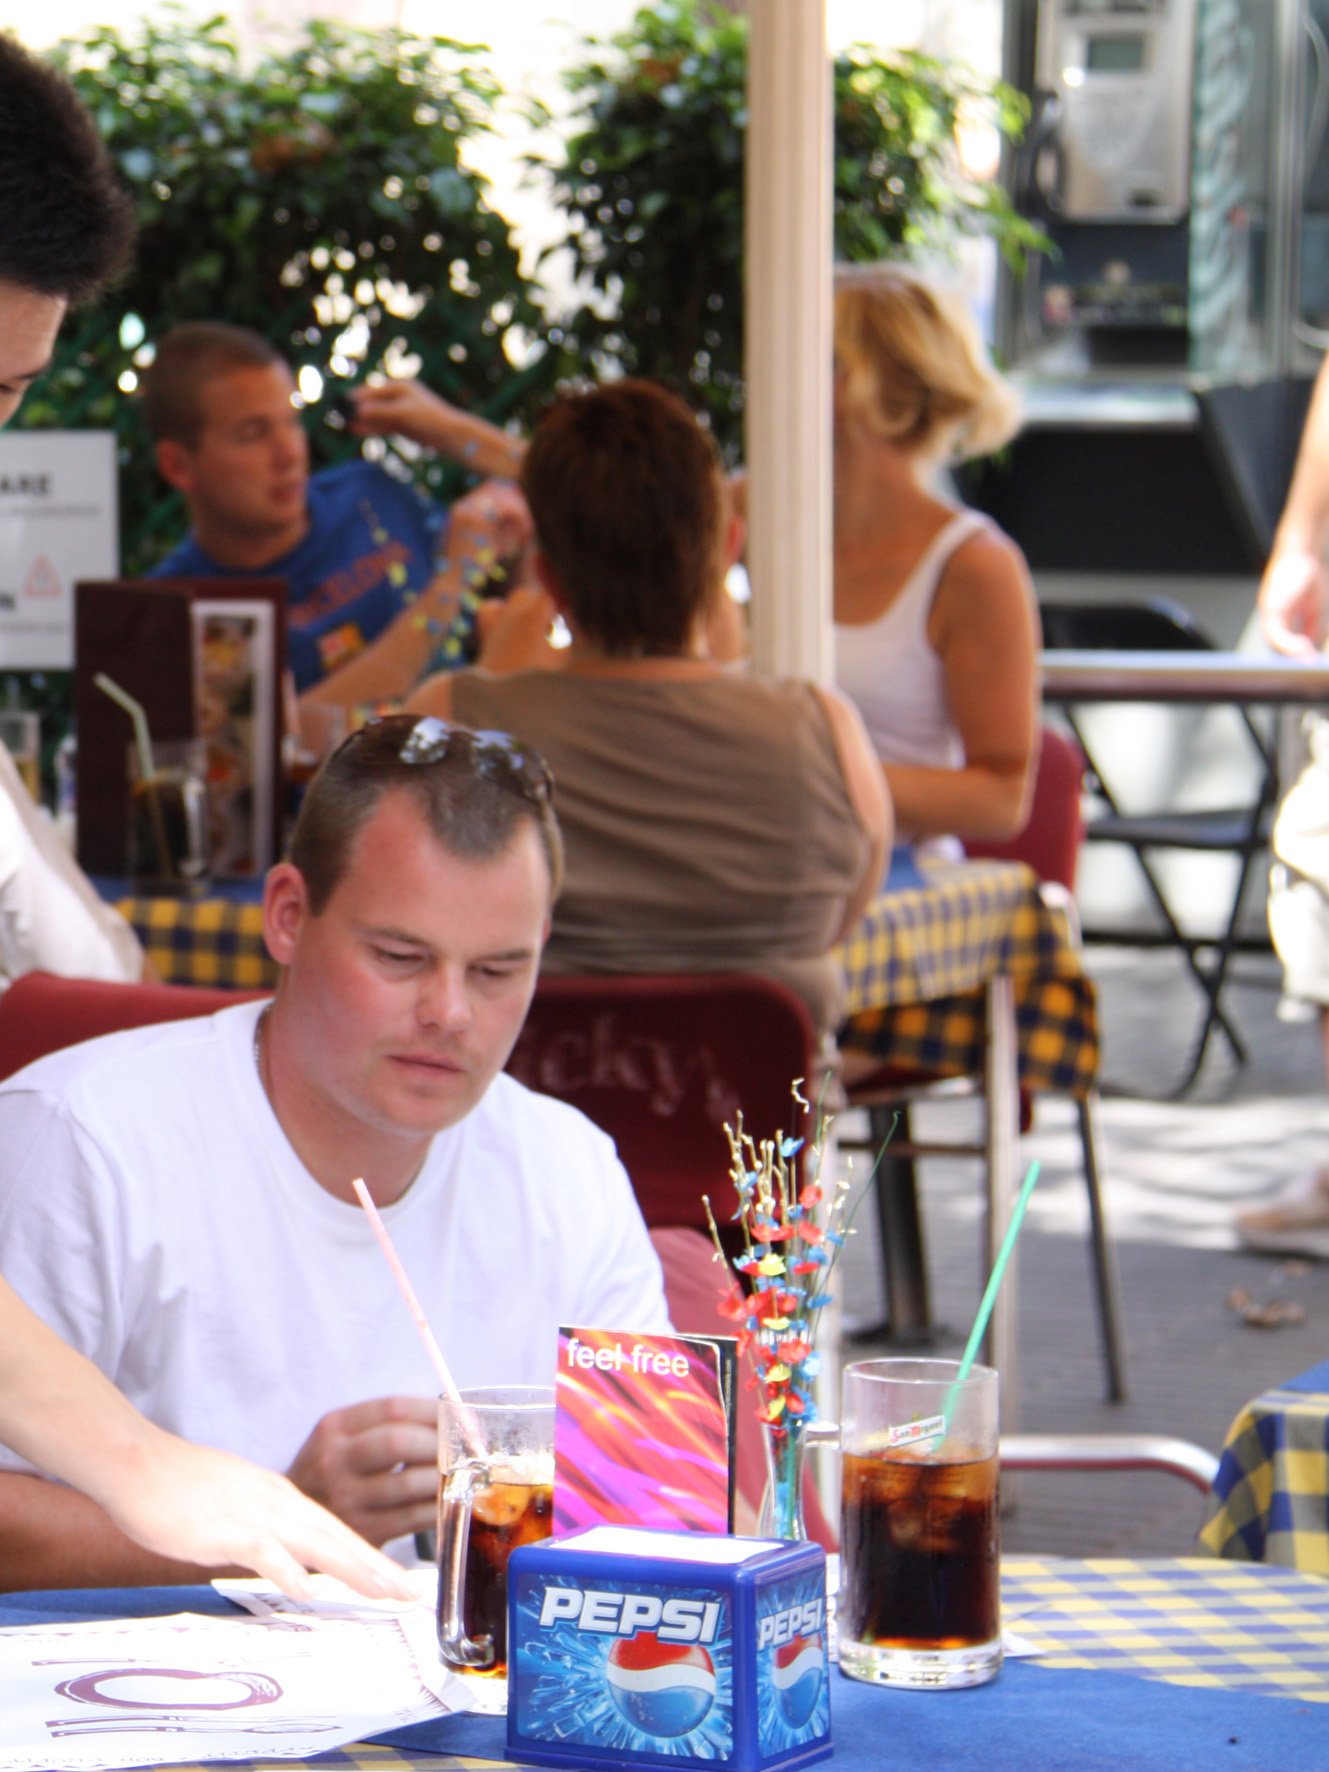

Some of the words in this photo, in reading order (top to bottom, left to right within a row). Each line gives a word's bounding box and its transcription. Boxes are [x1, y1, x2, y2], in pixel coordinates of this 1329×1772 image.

[567, 1337, 622, 1371] feel
[631, 1344, 690, 1378] free
[538, 1586, 722, 1644] PEPSI
[757, 1598, 823, 1650] PEPSI
